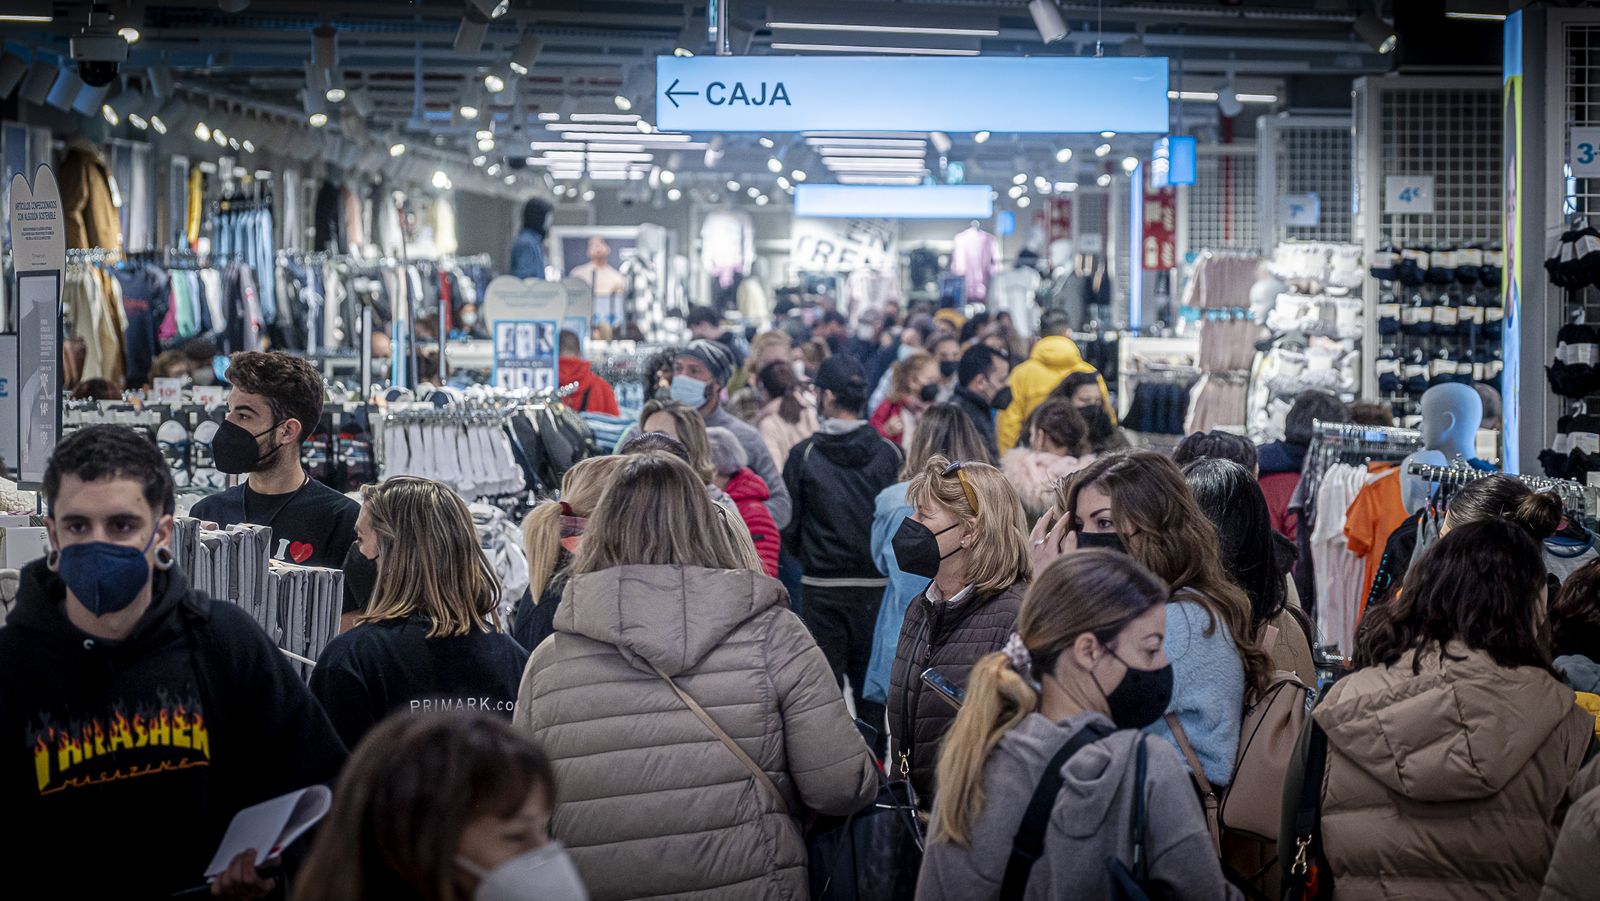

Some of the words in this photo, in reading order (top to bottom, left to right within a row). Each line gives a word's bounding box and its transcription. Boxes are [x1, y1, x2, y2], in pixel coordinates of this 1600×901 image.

[706, 82, 792, 106] CAJA
[273, 538, 291, 560] I
[410, 696, 519, 714] PRIMARK.co
[33, 703, 210, 792] THRASHER
[50, 757, 206, 792] MAGAZINE
